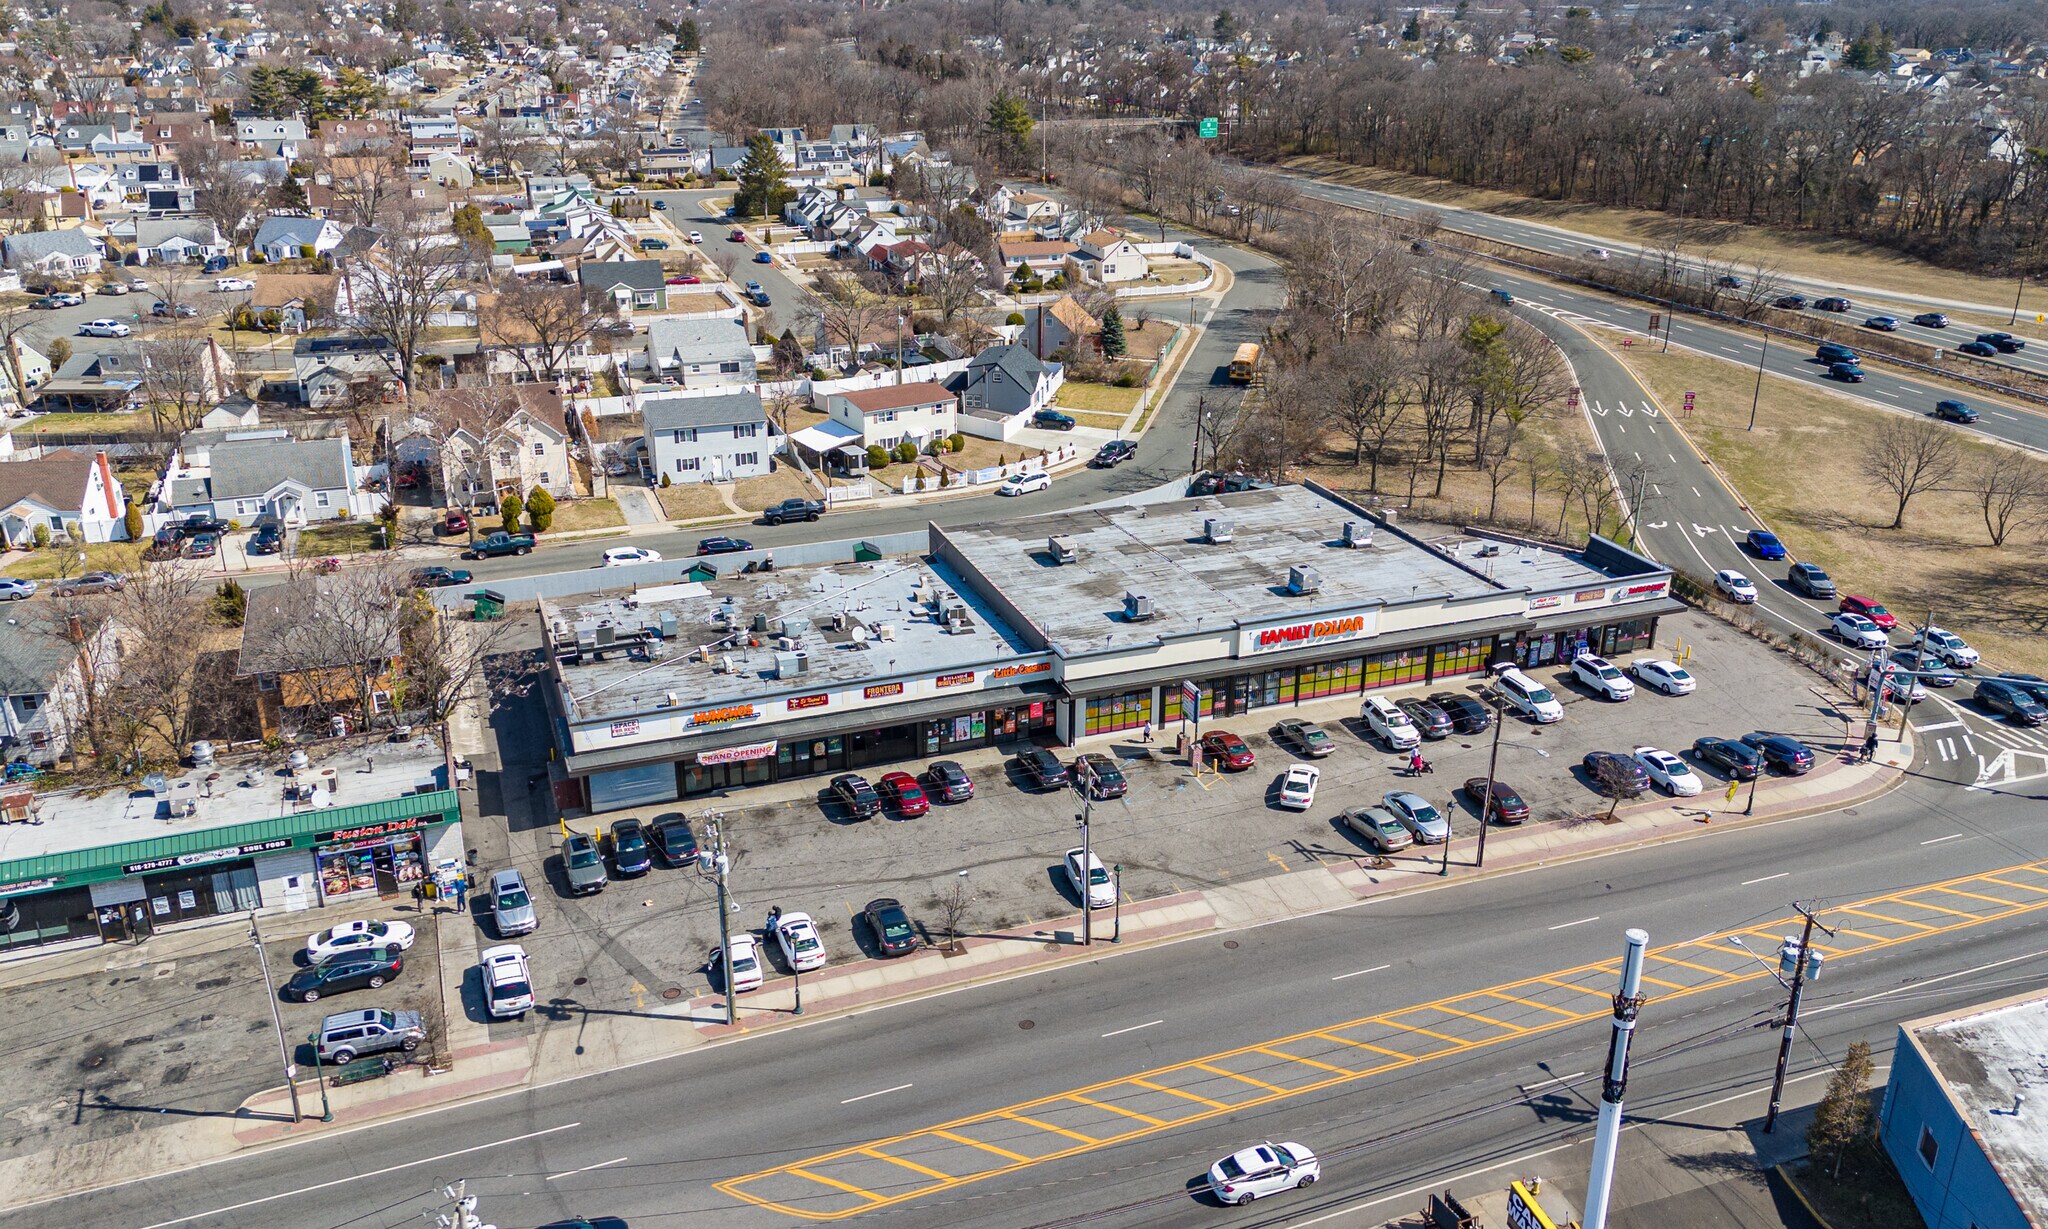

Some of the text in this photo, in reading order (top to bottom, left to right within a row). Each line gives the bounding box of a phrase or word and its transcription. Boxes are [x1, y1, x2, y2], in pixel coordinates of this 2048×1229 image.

[1260, 616, 1364, 645] FAMILY DOLLAR
[994, 662, 1051, 678] Little Caesars
[693, 703, 754, 723] HUNCHOS
[613, 721, 637, 729] SPACE
[702, 746, 773, 762] GRAND OPENING
[332, 824, 384, 840] Fusion
[386, 818, 417, 832] Deli
[243, 840, 286, 853] SOUL FOOD
[367, 838, 385, 846] FOOD
